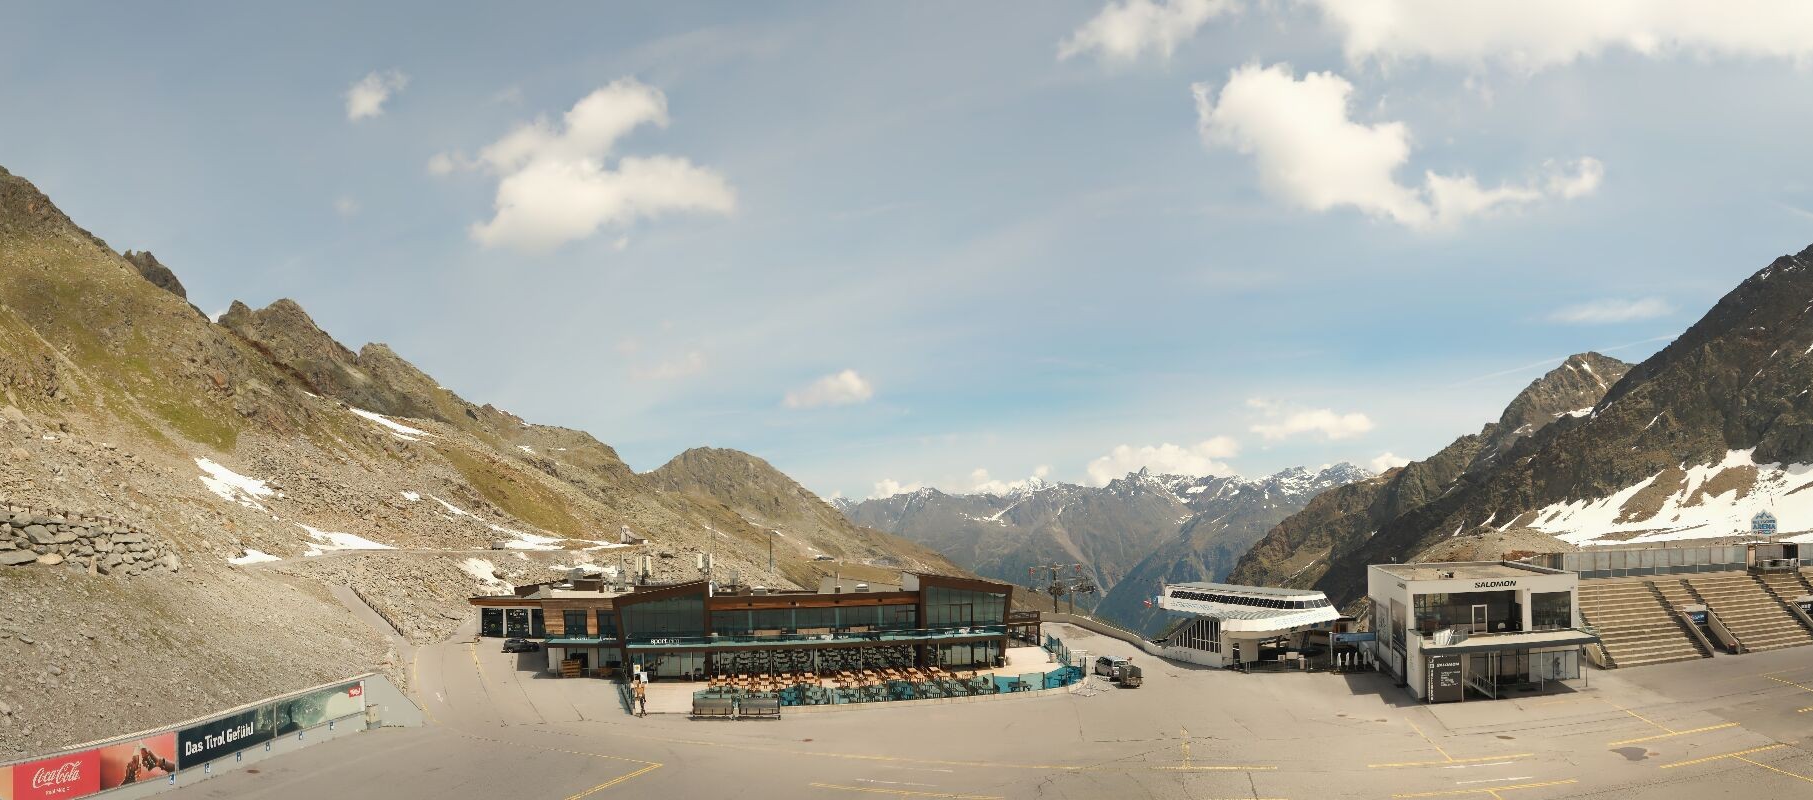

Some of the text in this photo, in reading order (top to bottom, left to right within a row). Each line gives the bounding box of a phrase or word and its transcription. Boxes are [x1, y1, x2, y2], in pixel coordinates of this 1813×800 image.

[1474, 580, 1517, 588] SALOMON
[185, 721, 254, 756] Das Tirol Gefühl
